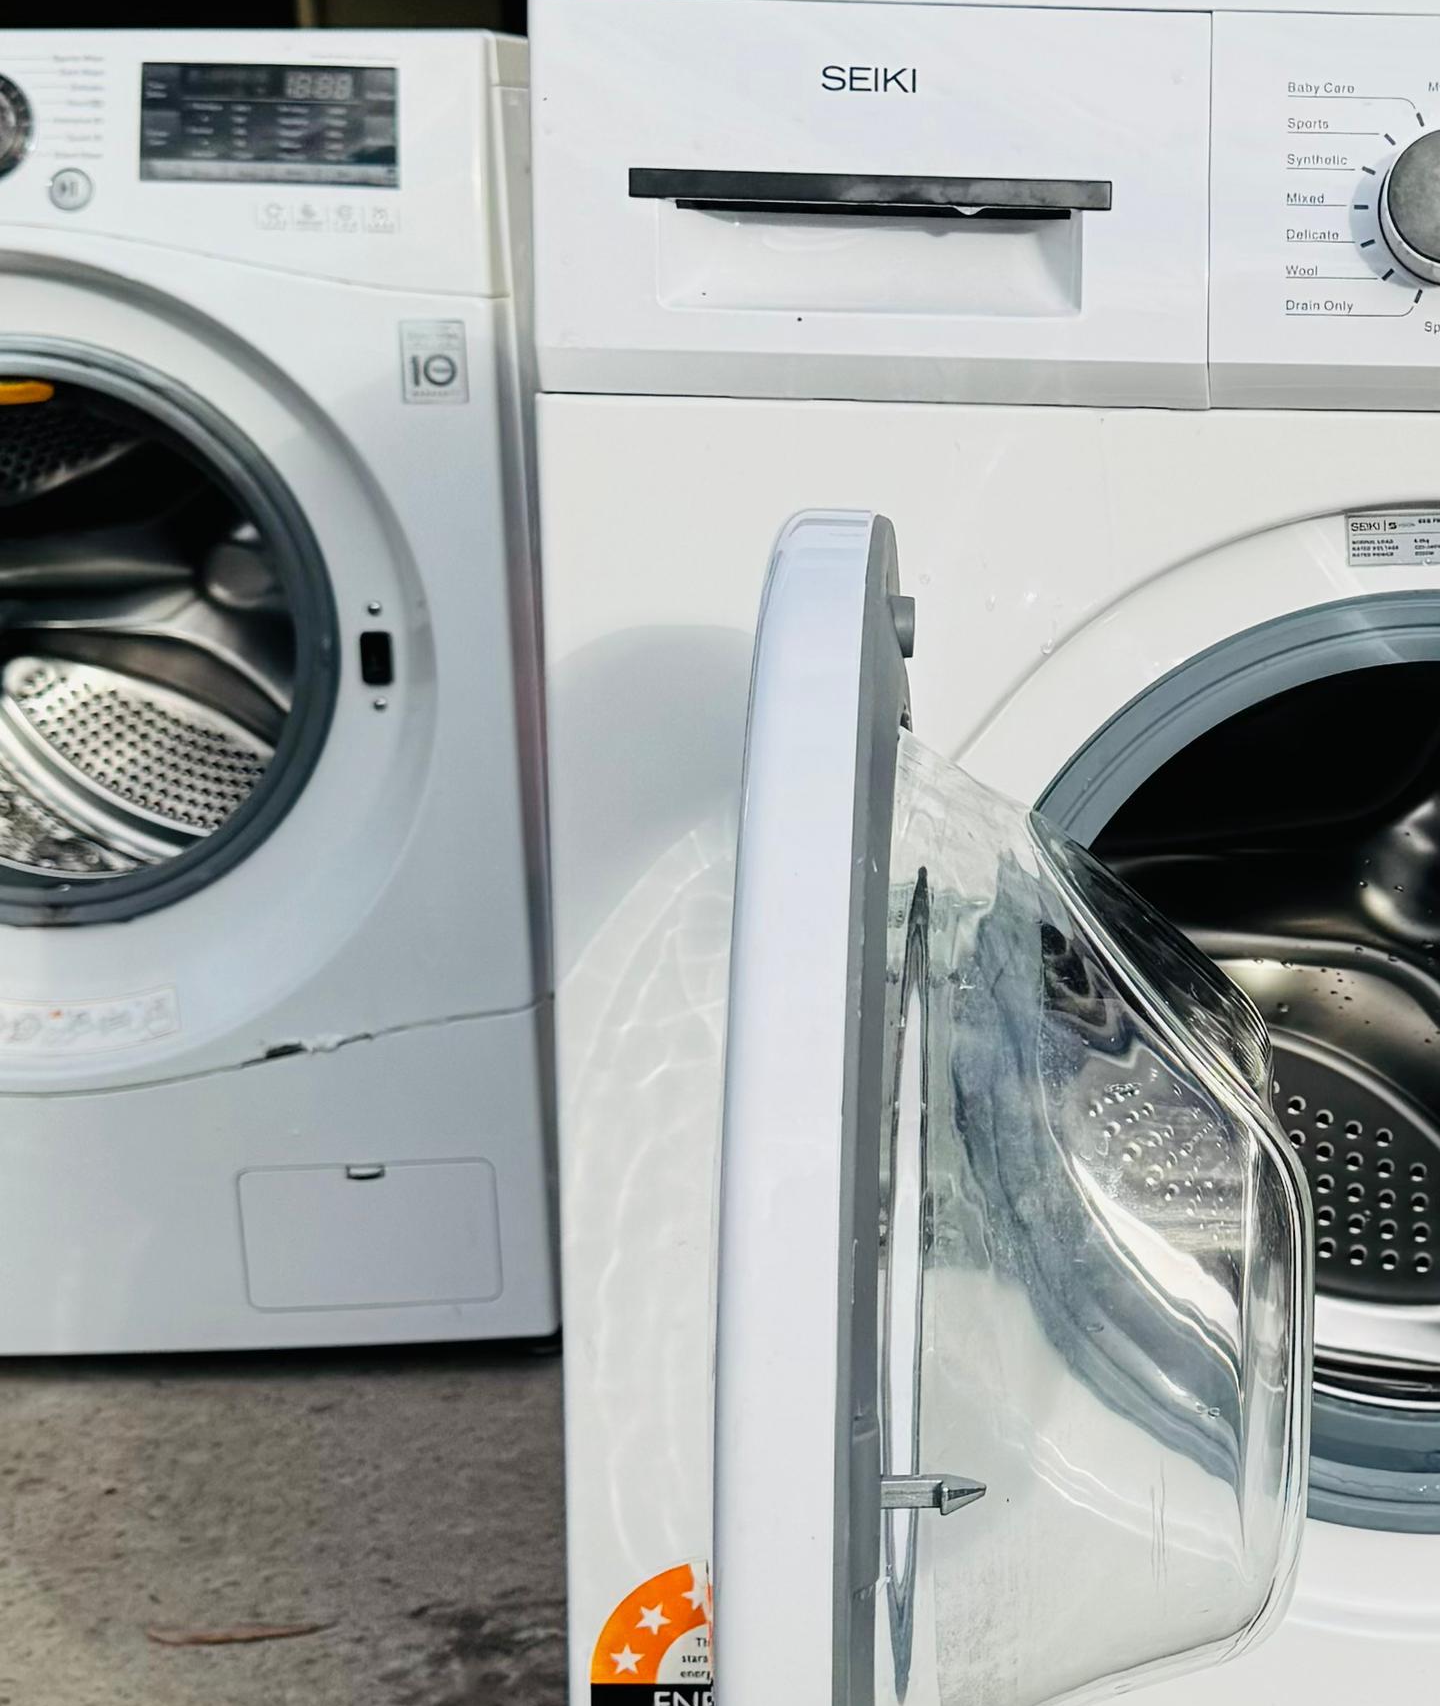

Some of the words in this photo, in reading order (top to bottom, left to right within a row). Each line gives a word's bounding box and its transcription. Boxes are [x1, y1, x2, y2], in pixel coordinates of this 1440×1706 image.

[821, 65, 917, 94] SEIKI
[1287, 81, 1320, 96] Baby
[1323, 82, 1355, 93] Care
[1287, 117, 1329, 130] Sports
[1287, 153, 1348, 167] Synthetic
[1286, 192, 1325, 204] Mixed
[1286, 228, 1340, 240] Delicate
[1285, 264, 1318, 276] Wool
[1285, 299, 1320, 311] Drain
[1323, 300, 1354, 314] Only
